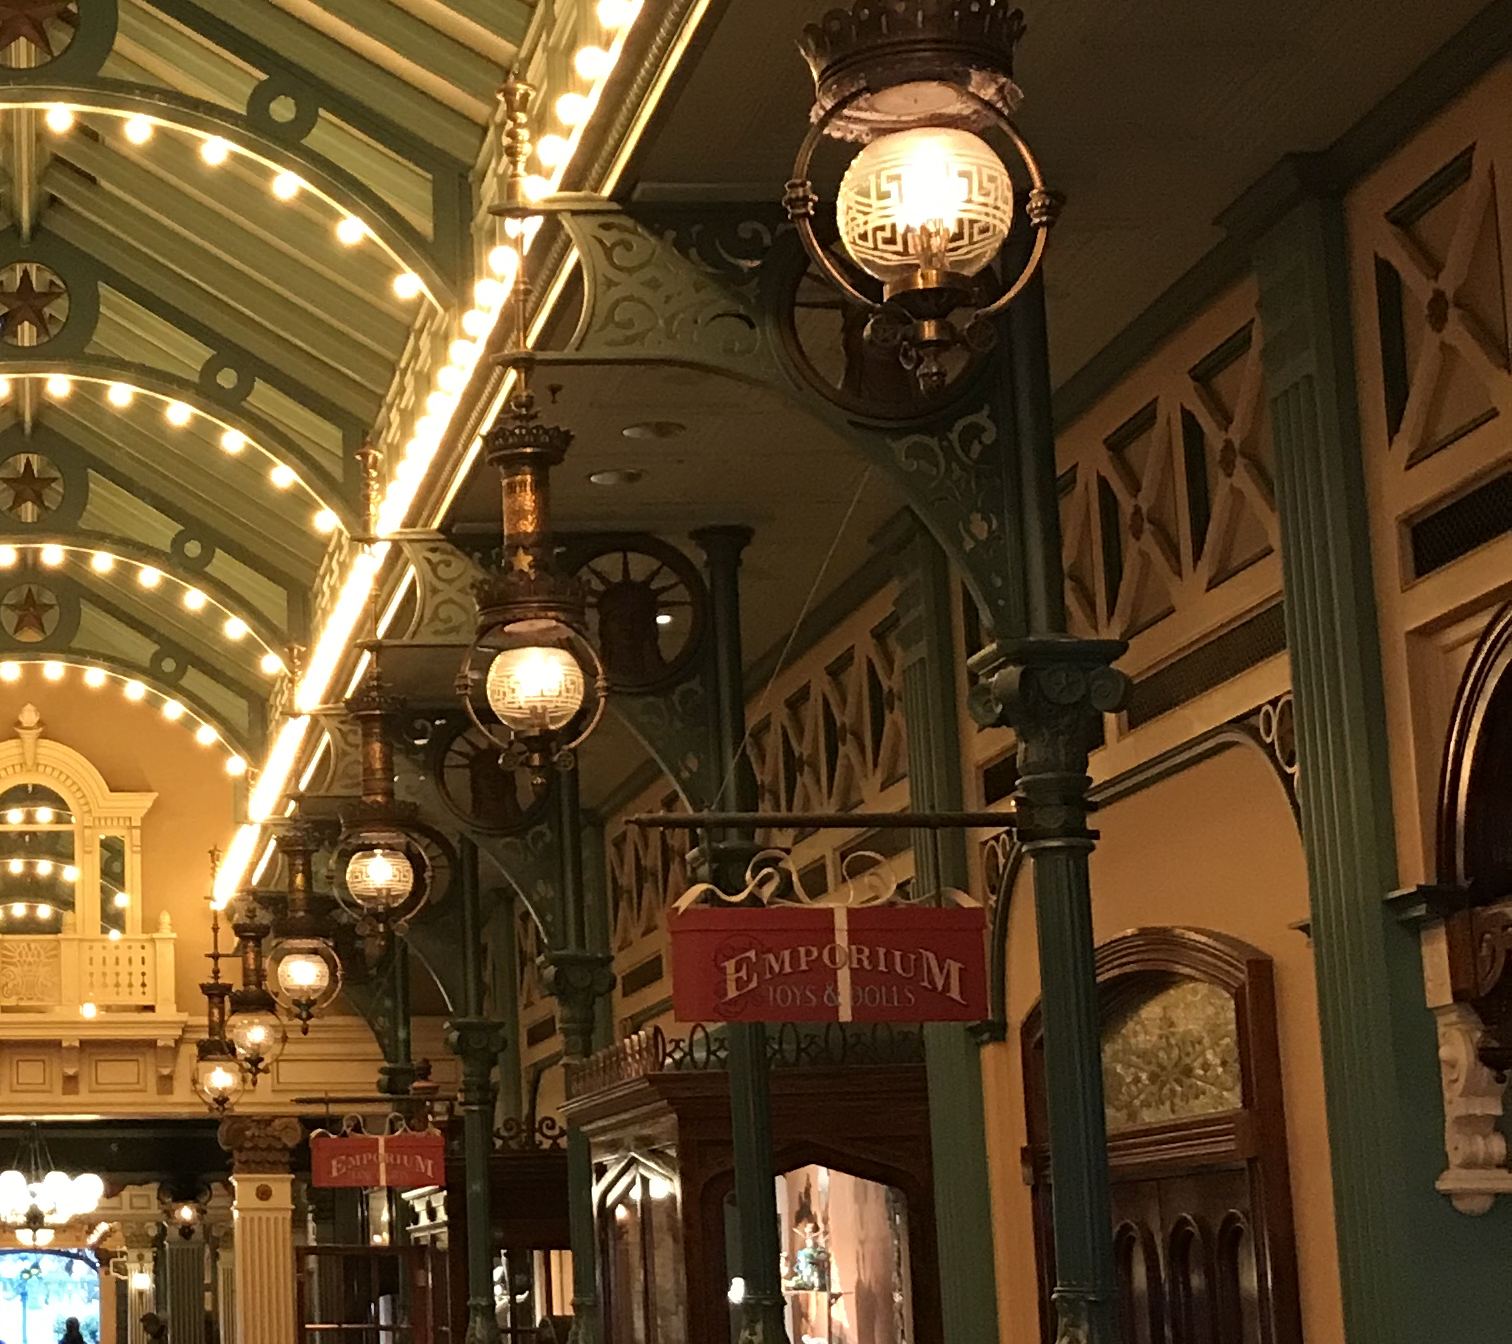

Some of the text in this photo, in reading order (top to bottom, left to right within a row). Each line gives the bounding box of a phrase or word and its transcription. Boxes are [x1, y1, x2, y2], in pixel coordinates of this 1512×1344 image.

[720, 943, 968, 1005] EMPORIUM
[767, 984, 818, 1008] TOYS
[823, 983, 841, 1008] &
[329, 1152, 435, 1178] EMPORIUM
